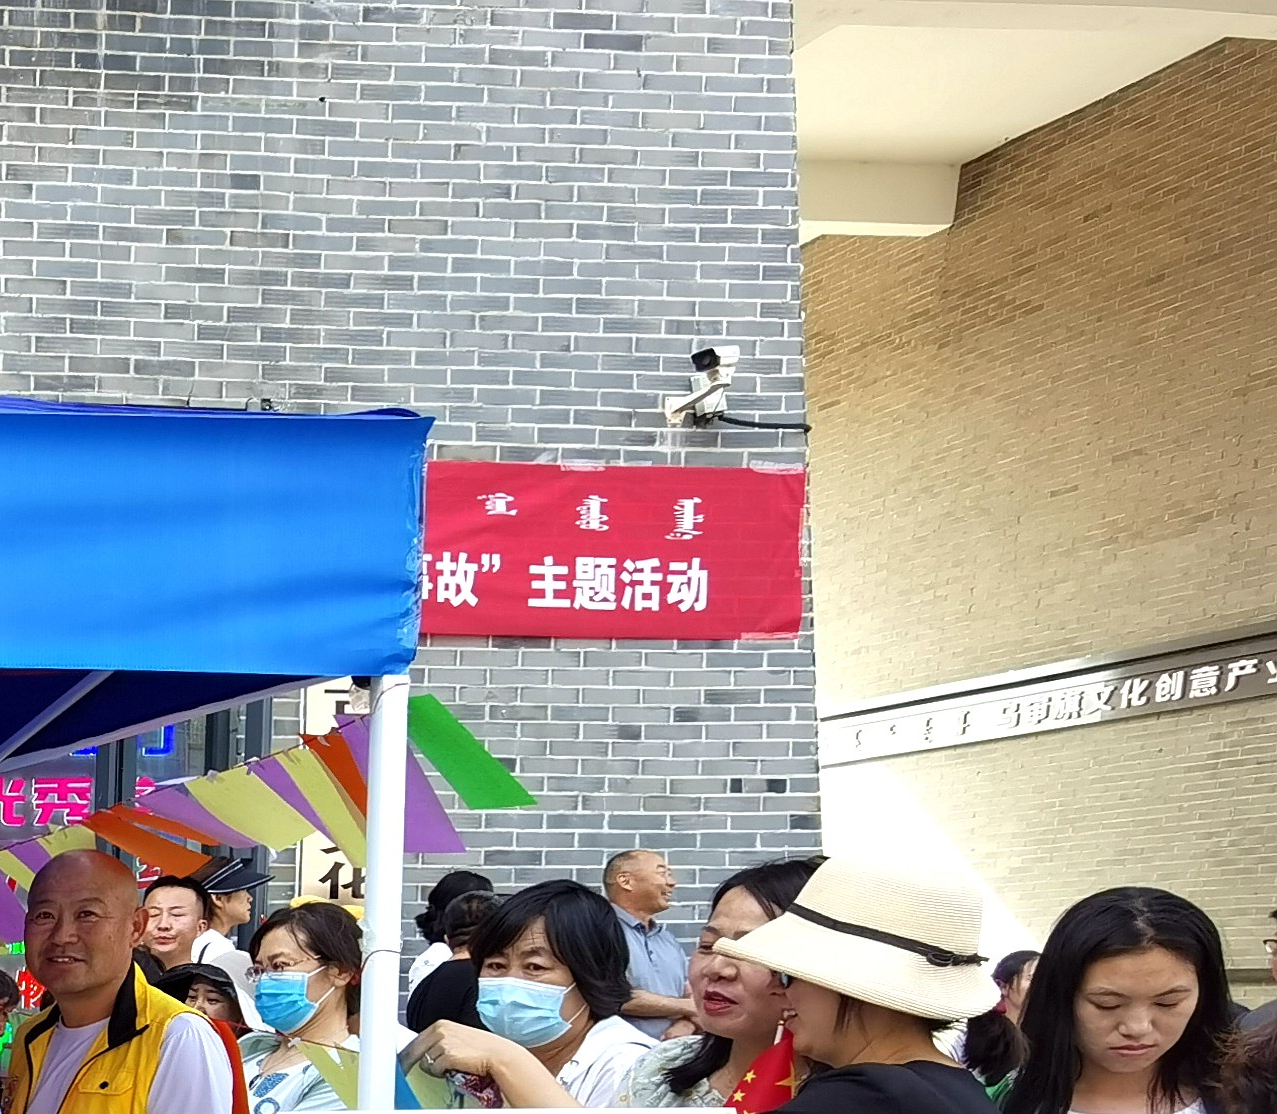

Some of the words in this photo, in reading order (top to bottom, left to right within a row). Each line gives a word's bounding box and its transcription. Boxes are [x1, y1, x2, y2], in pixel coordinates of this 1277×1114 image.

[527, 556, 708, 612] 主题活动
[996, 658, 1277, 730] 乌审旗文化创意产
